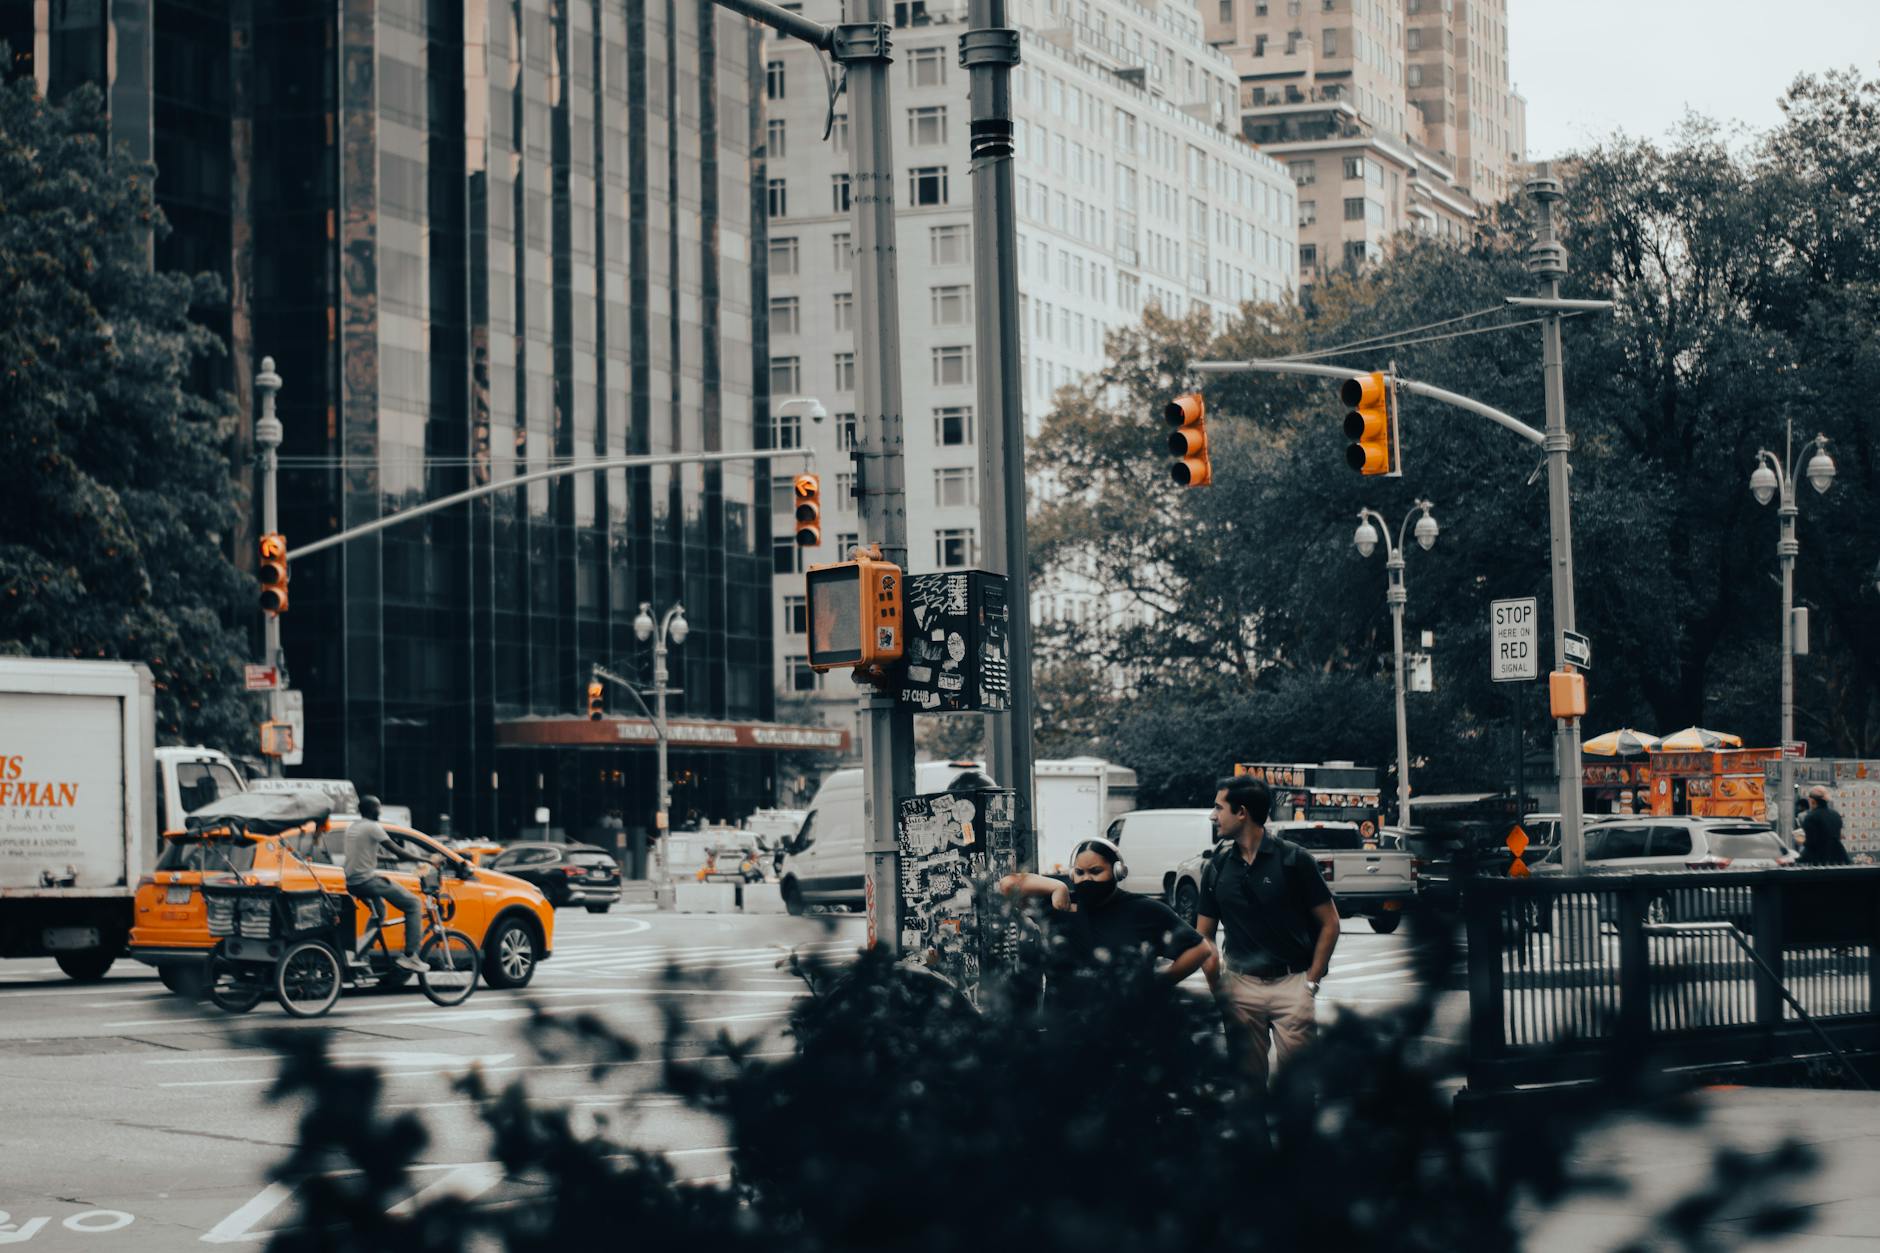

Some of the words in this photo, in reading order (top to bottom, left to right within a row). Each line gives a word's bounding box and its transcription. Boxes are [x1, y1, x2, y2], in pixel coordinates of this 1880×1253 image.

[1496, 606, 1532, 625] STOP
[1498, 628, 1517, 638] HERE
[1520, 627, 1530, 637] ON
[1500, 641, 1528, 660] RED
[1501, 663, 1528, 674] SIGNAL
[902, 689, 910, 702] 57
[911, 689, 930, 702] CLUB
